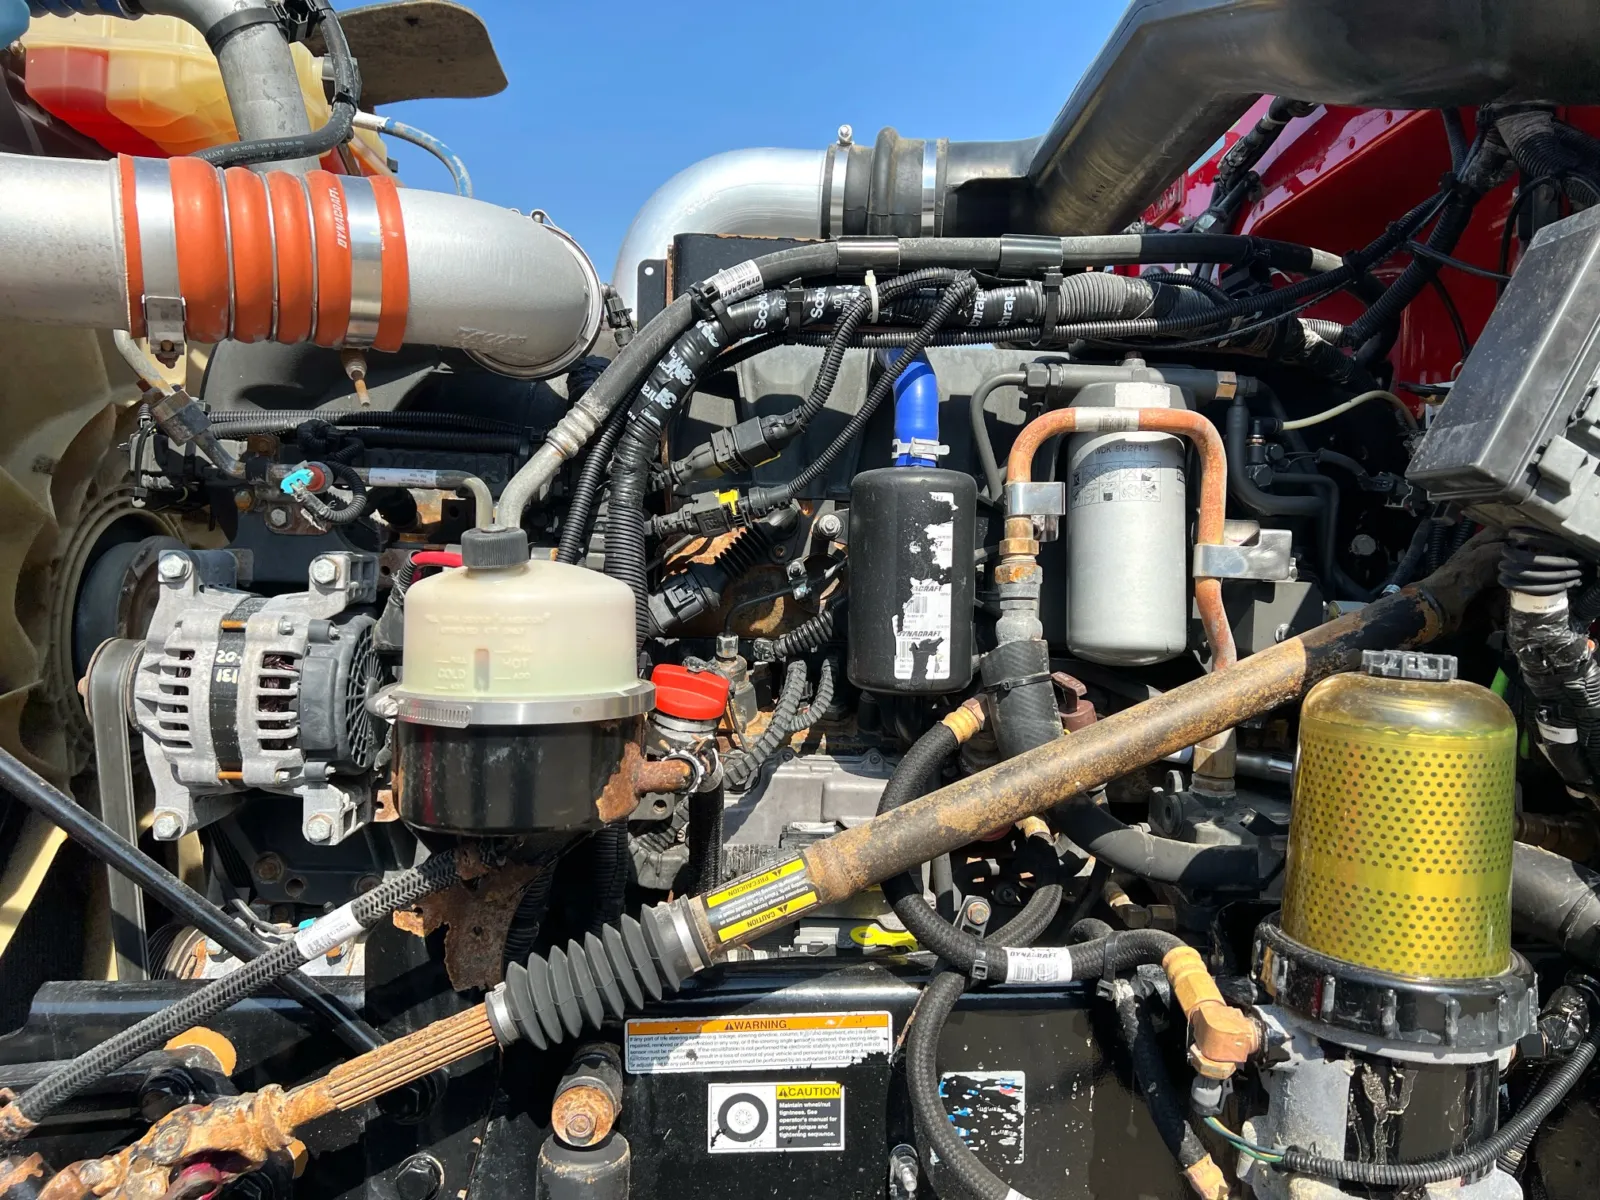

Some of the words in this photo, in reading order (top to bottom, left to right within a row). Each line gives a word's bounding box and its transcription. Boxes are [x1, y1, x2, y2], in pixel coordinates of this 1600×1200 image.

[328, 187, 348, 248] DYNACRAFT
[1095, 446, 1112, 455] WDK
[438, 668, 466, 679] COLD
[746, 910, 775, 927] CAUTION
[734, 1019, 786, 1029] WARNING
[788, 1087, 839, 1096] CAUTION
